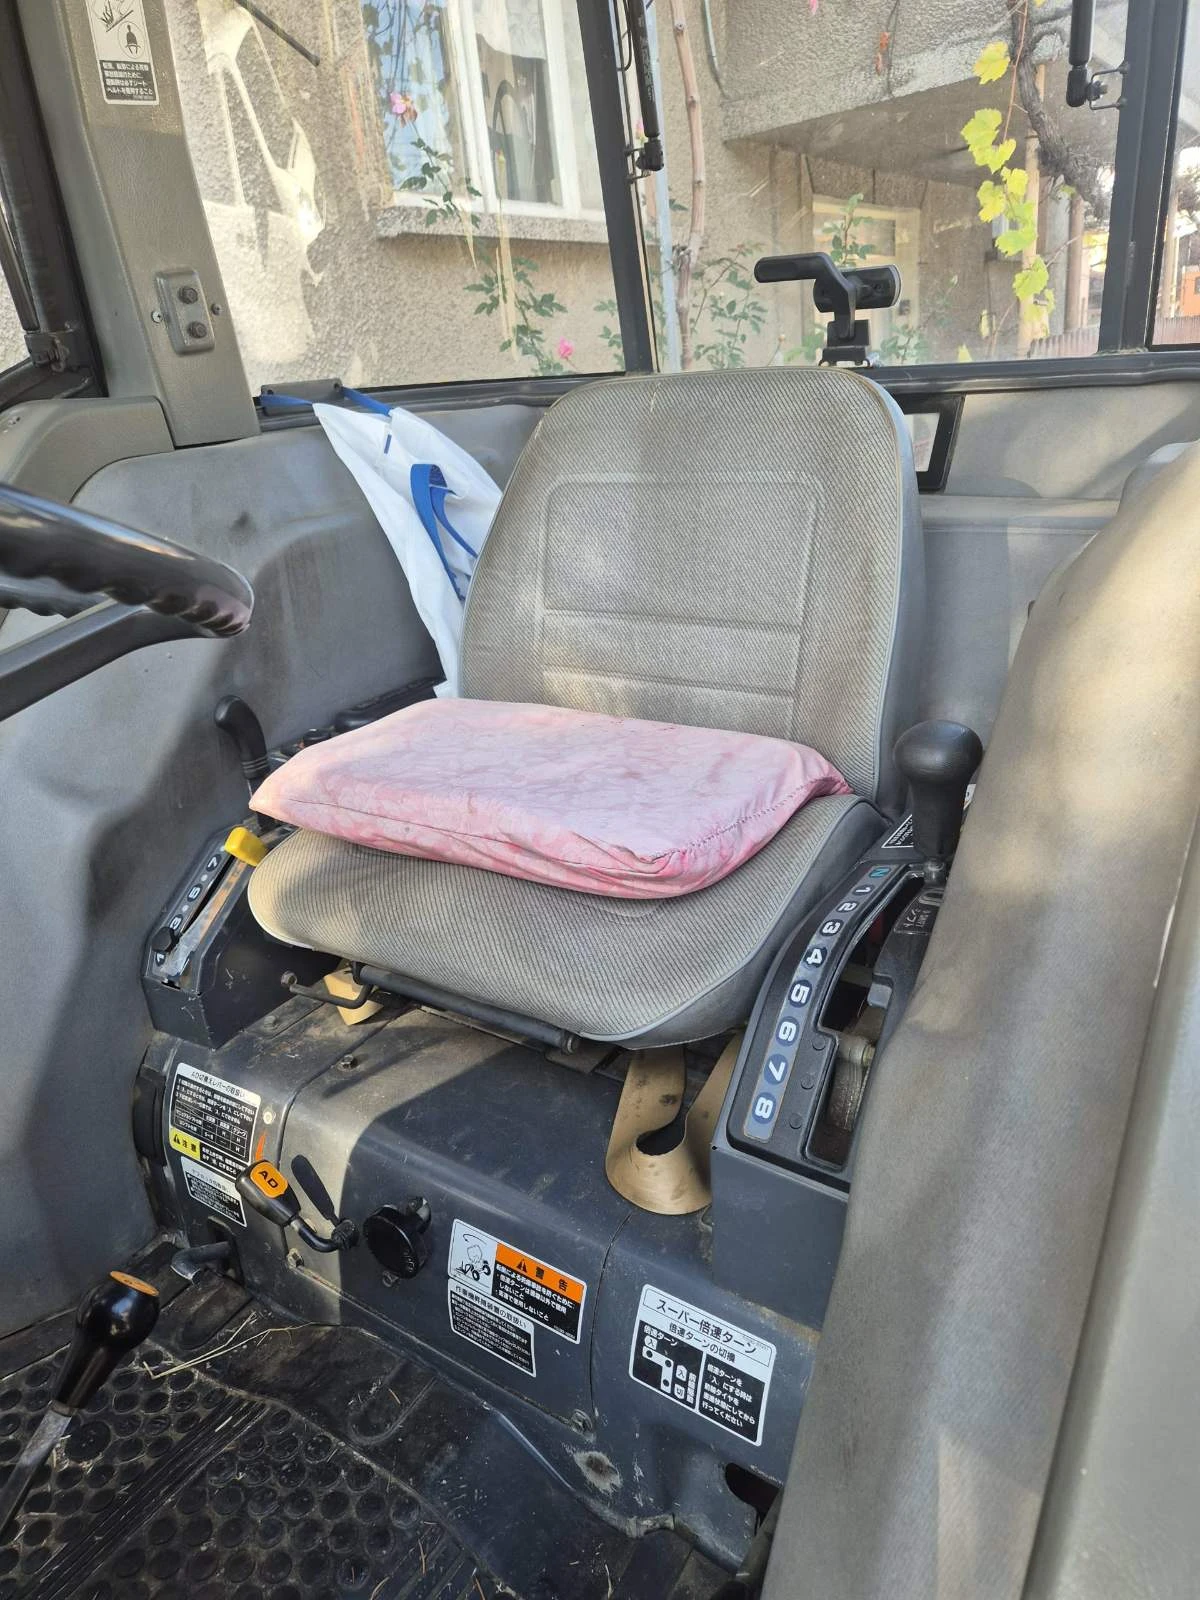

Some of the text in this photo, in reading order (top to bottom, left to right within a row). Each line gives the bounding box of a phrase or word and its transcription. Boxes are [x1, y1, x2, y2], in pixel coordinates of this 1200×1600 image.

[839, 902, 854, 912] 2
[822, 921, 840, 935] 3
[806, 948, 825, 966] 4
[790, 984, 809, 1005] 5
[779, 1021, 796, 1042] 6
[768, 1061, 786, 1081] 7
[755, 1096, 773, 1119] 8
[258, 1170, 279, 1188] AD
[643, 1324, 677, 1347] 倍速ターン
[657, 1299, 757, 1354] スーパー倍速ターン
